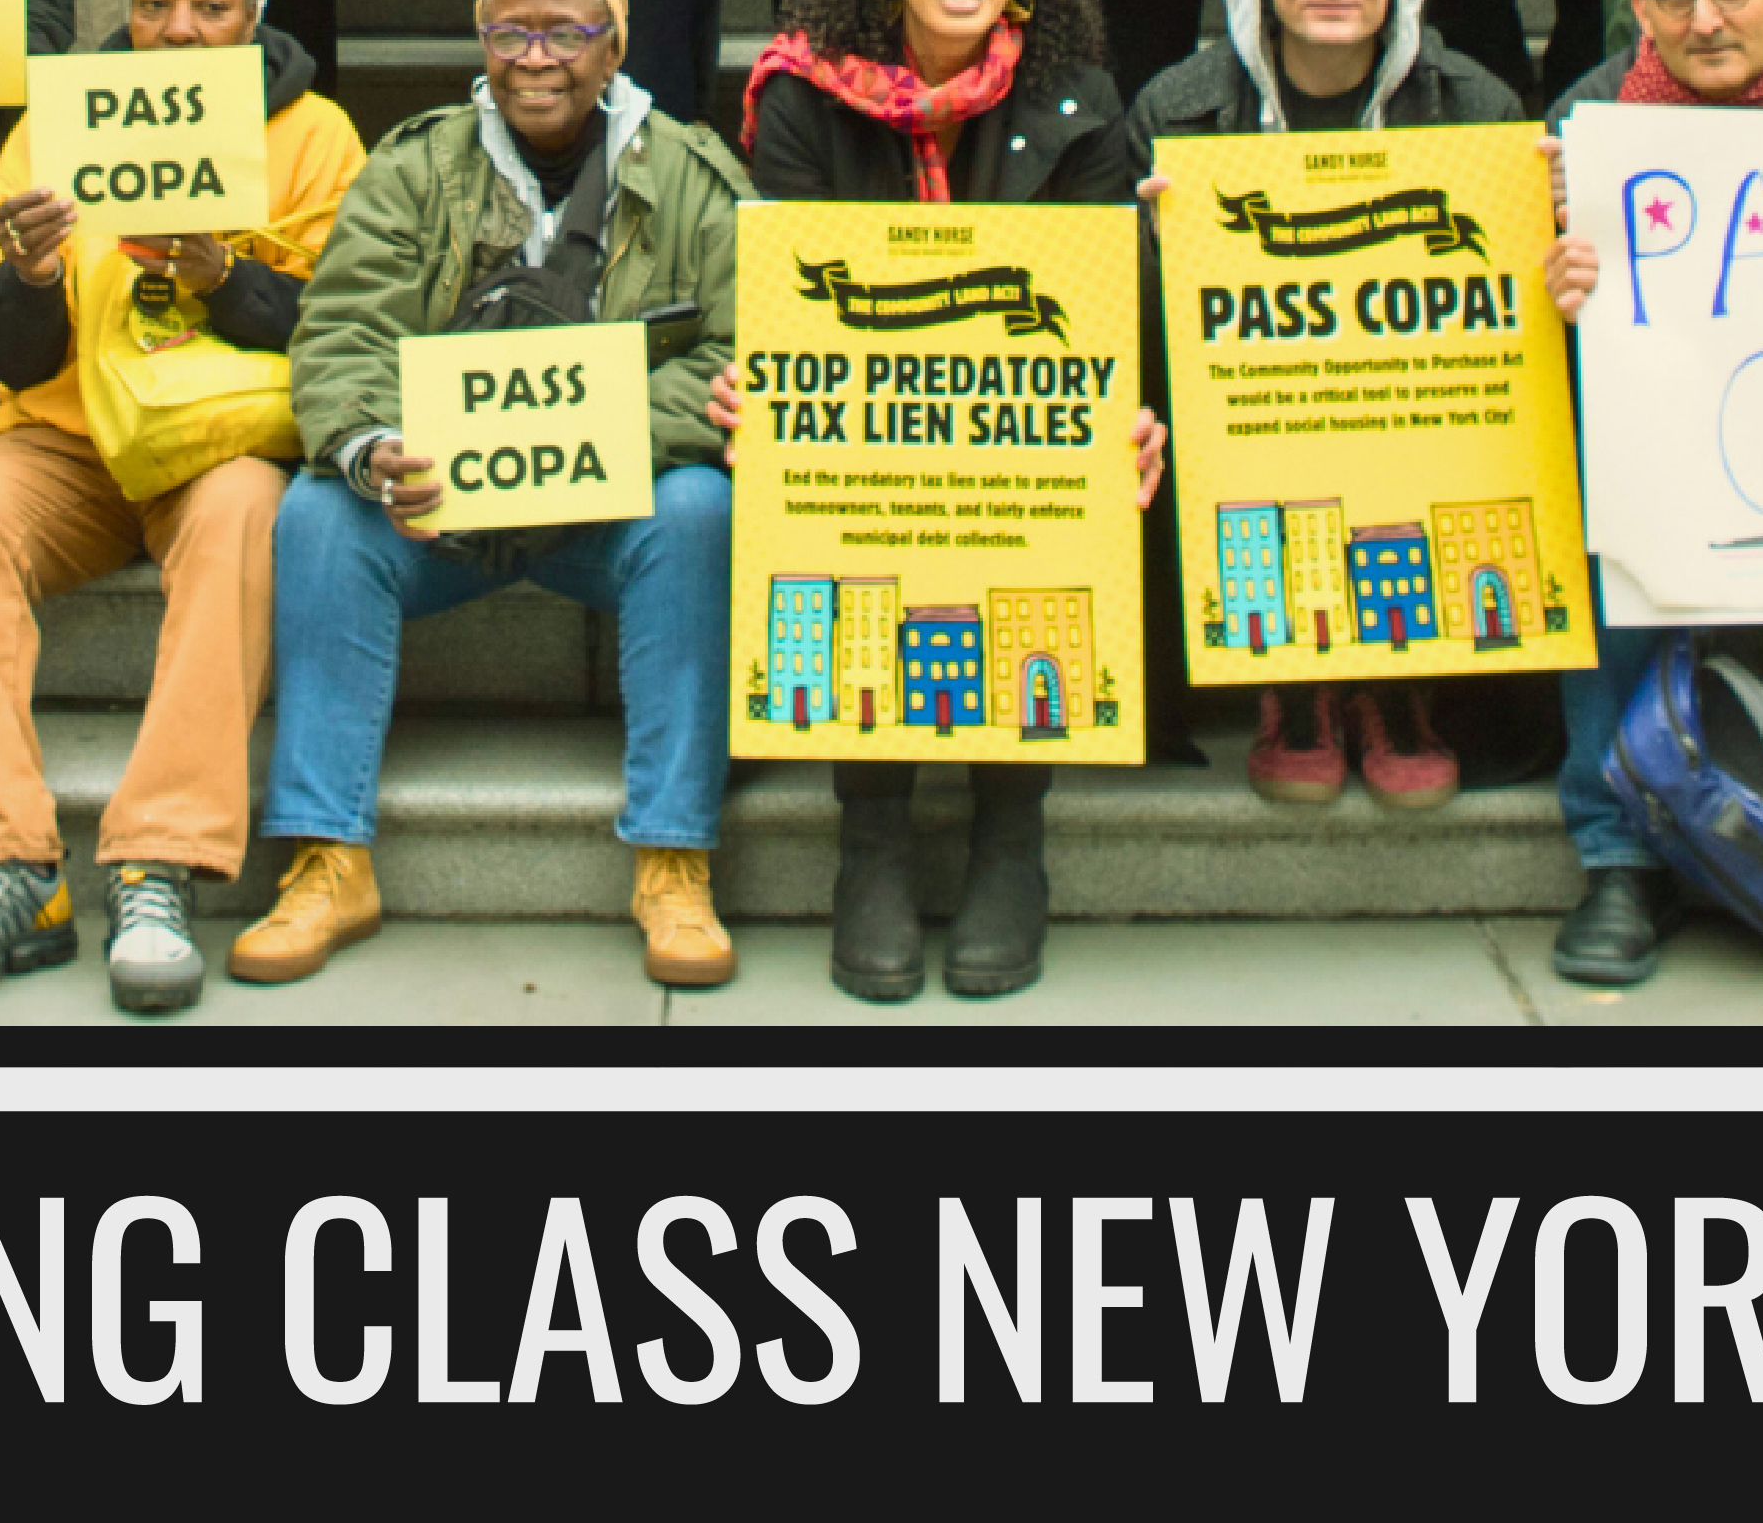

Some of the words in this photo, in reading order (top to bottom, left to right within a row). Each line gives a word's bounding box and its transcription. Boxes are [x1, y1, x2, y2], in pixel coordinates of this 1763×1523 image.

[86, 84, 205, 128] PASS
[72, 157, 225, 204] COPA
[1200, 281, 1339, 342] PASS
[1355, 274, 1519, 335] COPA!
[746, 351, 851, 393] STOP
[865, 354, 1116, 398] PREDATORY
[1209, 364, 1234, 379] The
[1239, 361, 1319, 378] Community
[1324, 357, 1408, 375] Opportunity
[1413, 356, 1427, 371] to
[1432, 353, 1497, 369] Purchase
[1503, 351, 1523, 367] Act
[462, 362, 587, 413] PASS
[1227, 391, 1271, 406] would
[1275, 390, 1293, 405] be
[1299, 392, 1308, 404] a
[1313, 387, 1358, 403] critical
[1363, 386, 1391, 402] tool
[1396, 386, 1410, 400] to
[1415, 383, 1478, 402] preserve
[1484, 381, 1510, 397] and
[769, 401, 847, 443] TAX
[863, 402, 954, 444] LIEN
[968, 403, 1093, 445] SALES
[1227, 419, 1281, 436] expand
[1285, 417, 1325, 433] social
[1330, 415, 1388, 432] housing
[1393, 414, 1405, 429] in
[1410, 412, 1442, 427] New
[1448, 410, 1480, 425] York
[1484, 408, 1515, 425] City!
[449, 439, 607, 493] COPA
[784, 470, 810, 486] End
[815, 470, 839, 486] the
[844, 471, 914, 490] predatory
[921, 473, 942, 488] tax
[947, 471, 975, 488] lien
[980, 472, 1009, 489] sale
[1016, 474, 1030, 489] to
[1036, 474, 1087, 491] protect
[785, 500, 887, 516] homeowners,
[889, 501, 950, 517] tenants,
[956, 502, 981, 517] and
[986, 502, 1024, 519] fairly
[1030, 503, 1085, 519] enforce
[840, 530, 912, 546] municipal
[917, 530, 949, 546] debt
[955, 530, 1029, 547] collection.
